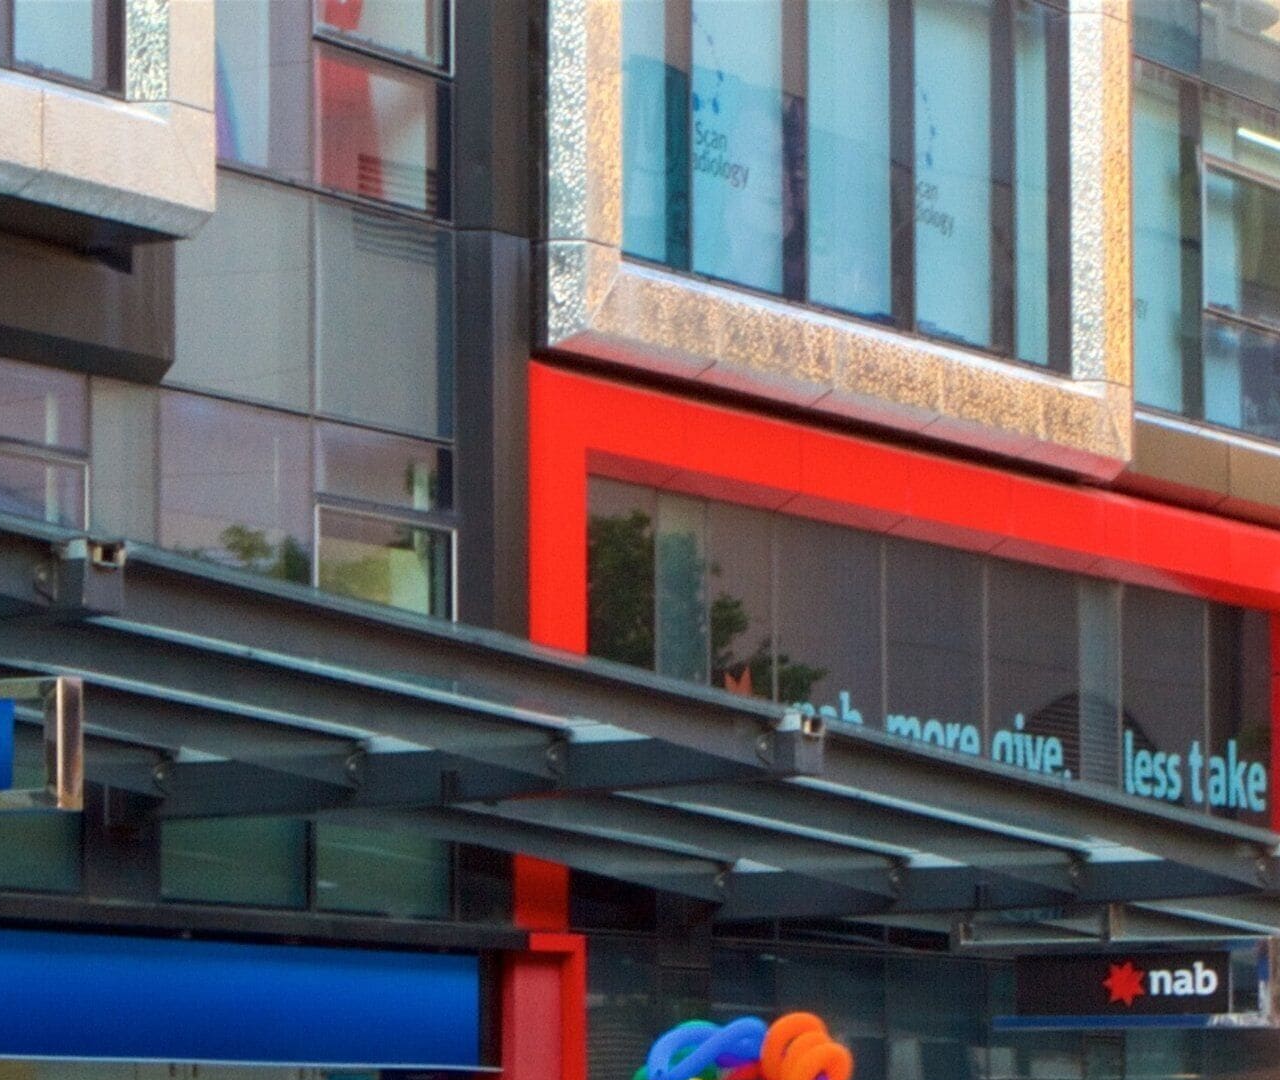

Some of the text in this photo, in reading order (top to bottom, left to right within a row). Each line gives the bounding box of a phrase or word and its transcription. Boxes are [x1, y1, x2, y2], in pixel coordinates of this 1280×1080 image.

[1124, 729, 1182, 800] less
[1189, 739, 1267, 812] take
[1149, 961, 1218, 995] nab
